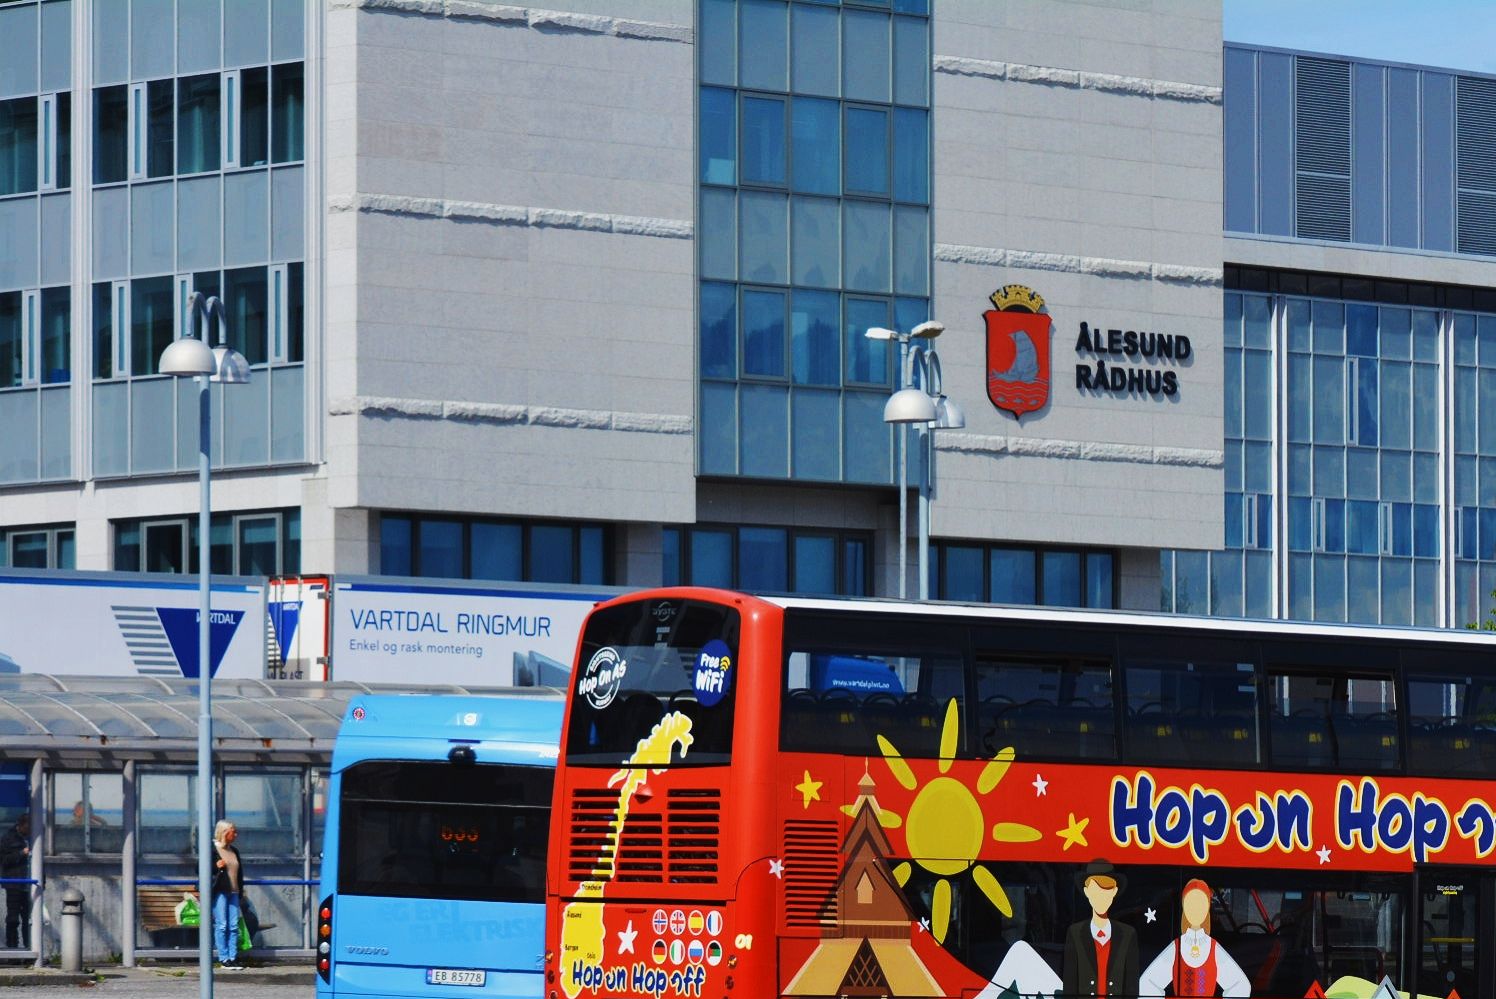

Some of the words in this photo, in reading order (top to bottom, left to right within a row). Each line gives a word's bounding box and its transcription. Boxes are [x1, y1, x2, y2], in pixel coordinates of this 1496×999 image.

[1075, 321, 1191, 360] ÅLESUND
[1075, 360, 1178, 395] RÅDHUS
[196, 611, 236, 625] VRTDAL
[350, 608, 449, 633] VARTDAL
[457, 613, 551, 637] RINGMUR
[349, 639, 380, 651] Enkel
[383, 642, 398, 654] og
[401, 641, 423, 653] rask
[426, 643, 484, 657] montering
[700, 652, 720, 668] Free
[579, 676, 598, 695] Hop
[598, 669, 612, 686] On
[612, 660, 627, 681] AS
[696, 669, 725, 693] WiFi
[1110, 770, 1231, 864] Hop
[1232, 790, 1313, 853] on
[1335, 776, 1450, 863] Hop
[434, 970, 448, 981] EB
[451, 971, 482, 983] 85778
[572, 960, 603, 994] Hop
[605, 966, 627, 992] on
[631, 962, 668, 999] Hop
[669, 964, 706, 998] off
